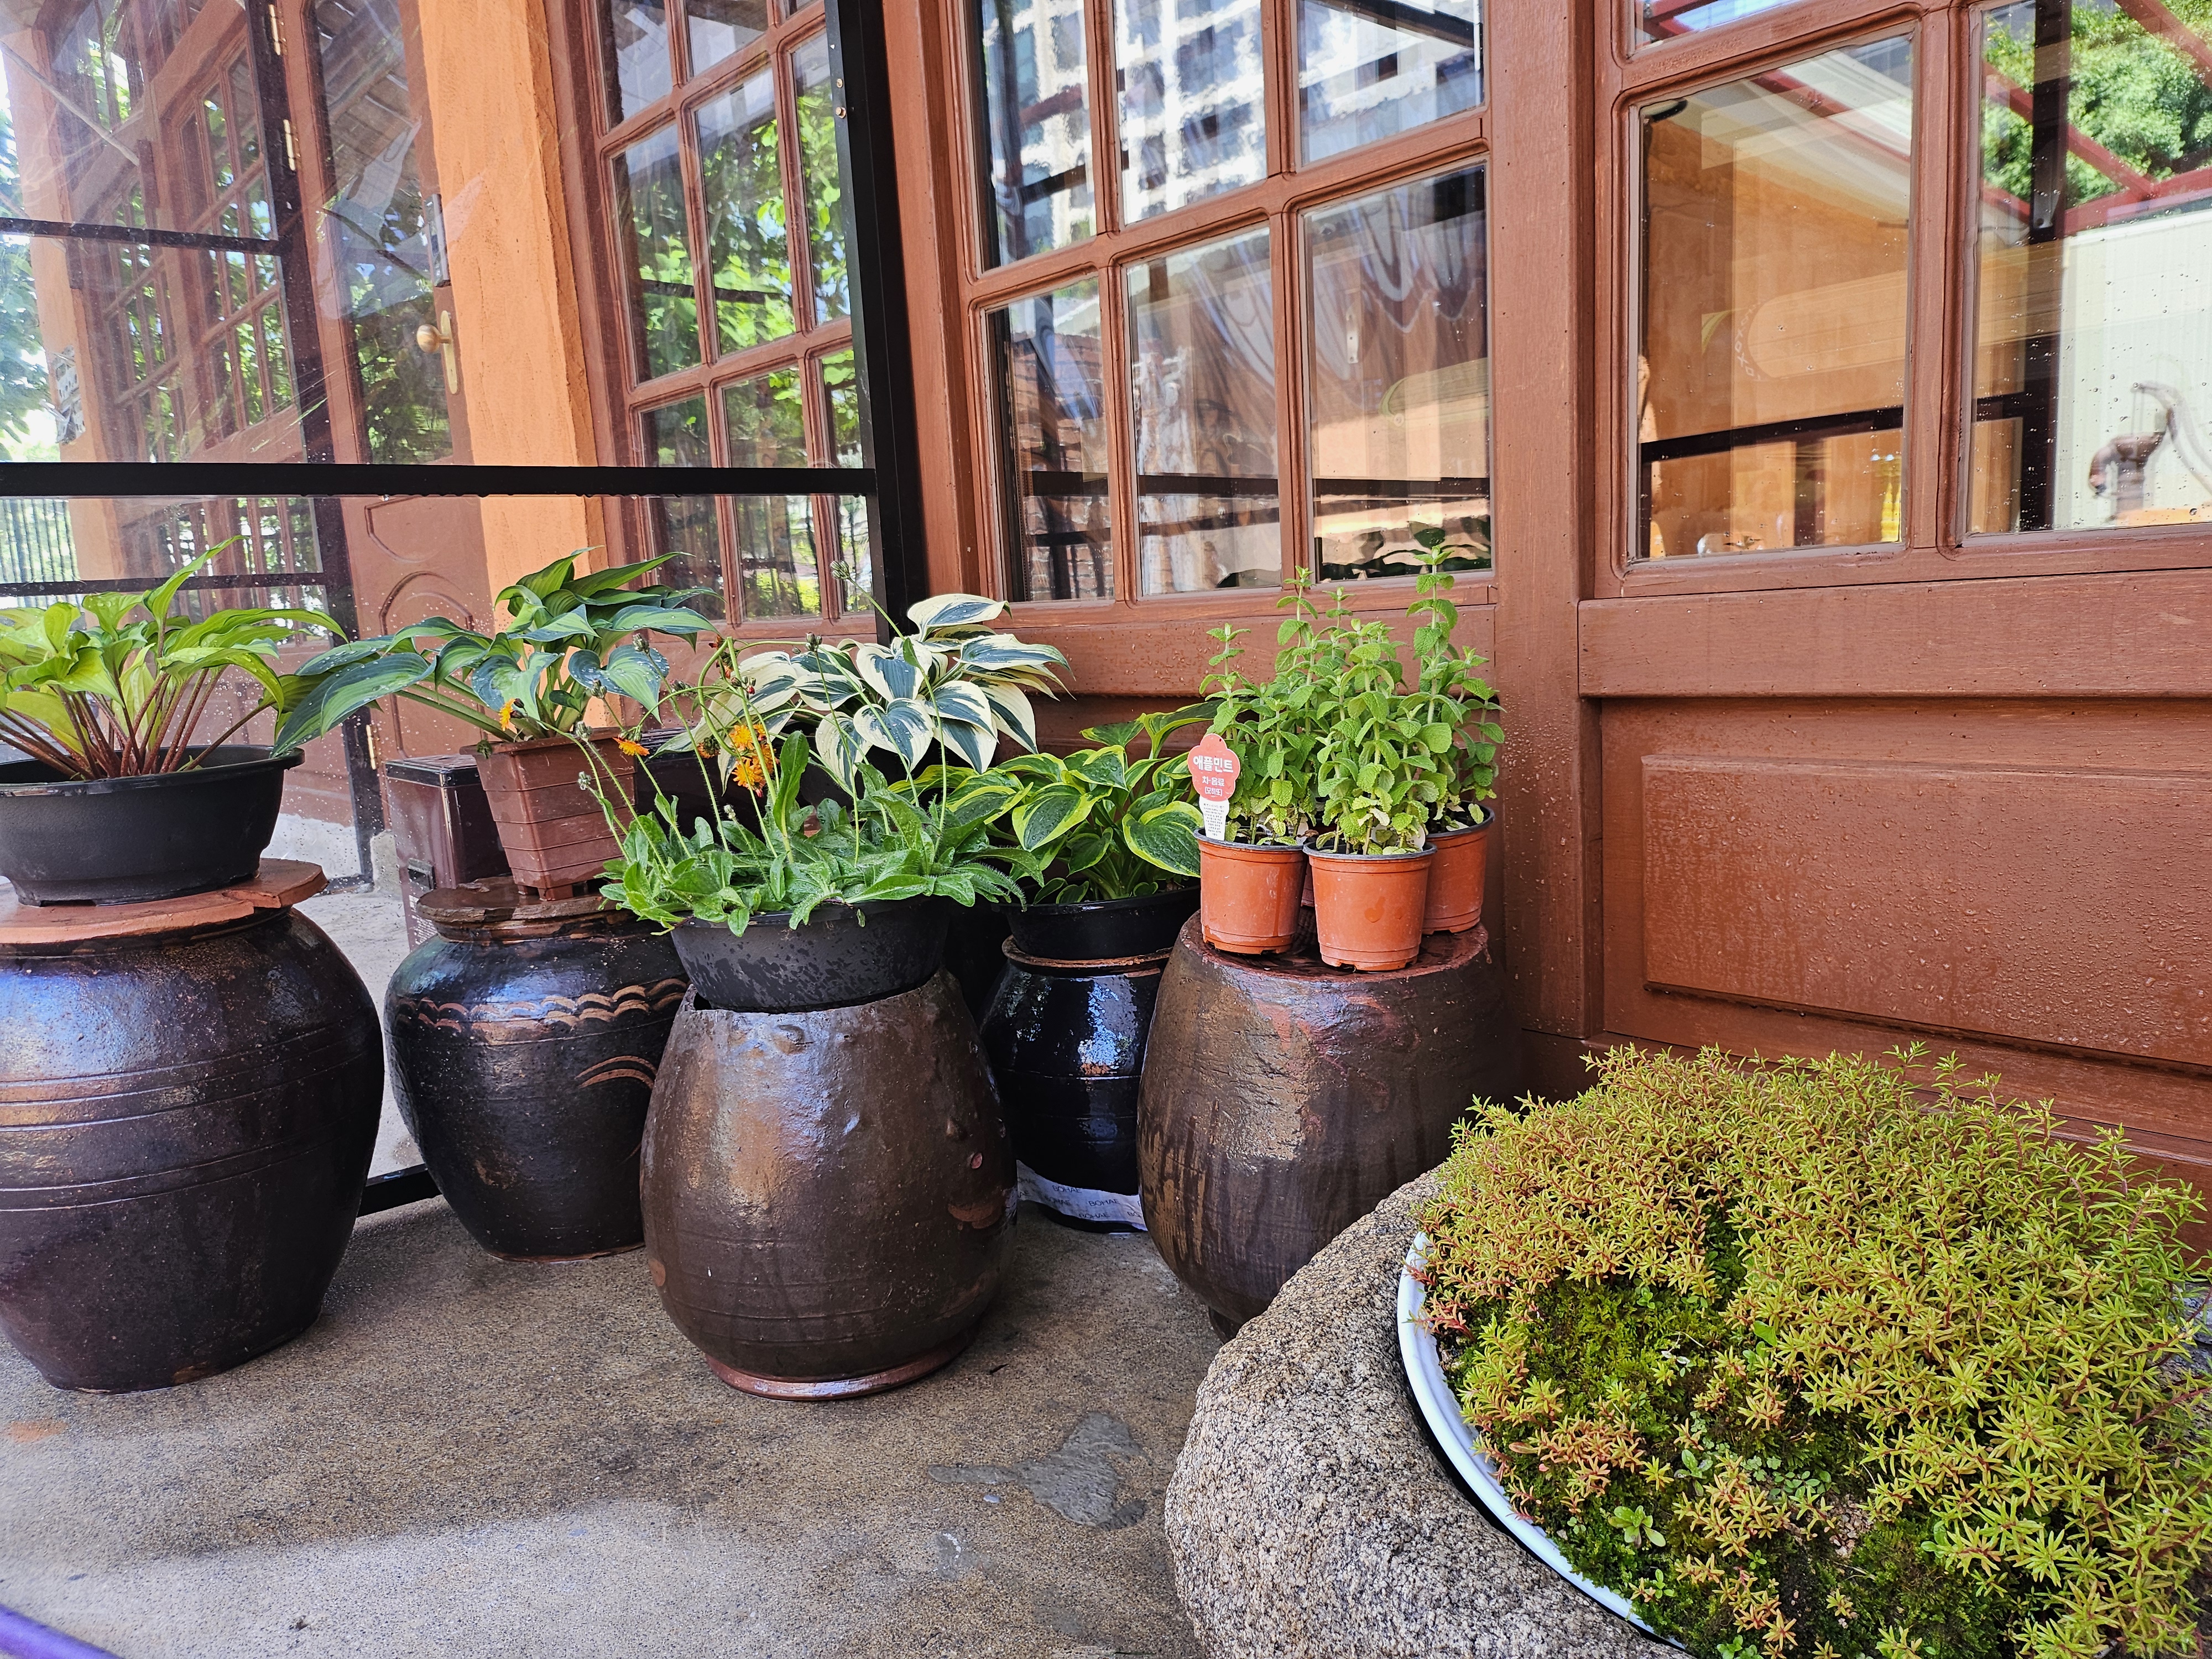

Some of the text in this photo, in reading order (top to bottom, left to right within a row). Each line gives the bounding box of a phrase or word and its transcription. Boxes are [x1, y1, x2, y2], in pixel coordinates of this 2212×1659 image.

[1193, 755, 1234, 773] 애플민트
[1204, 786, 1223, 796] (모히또)
[1052, 1185, 1082, 1193] BOHAE
